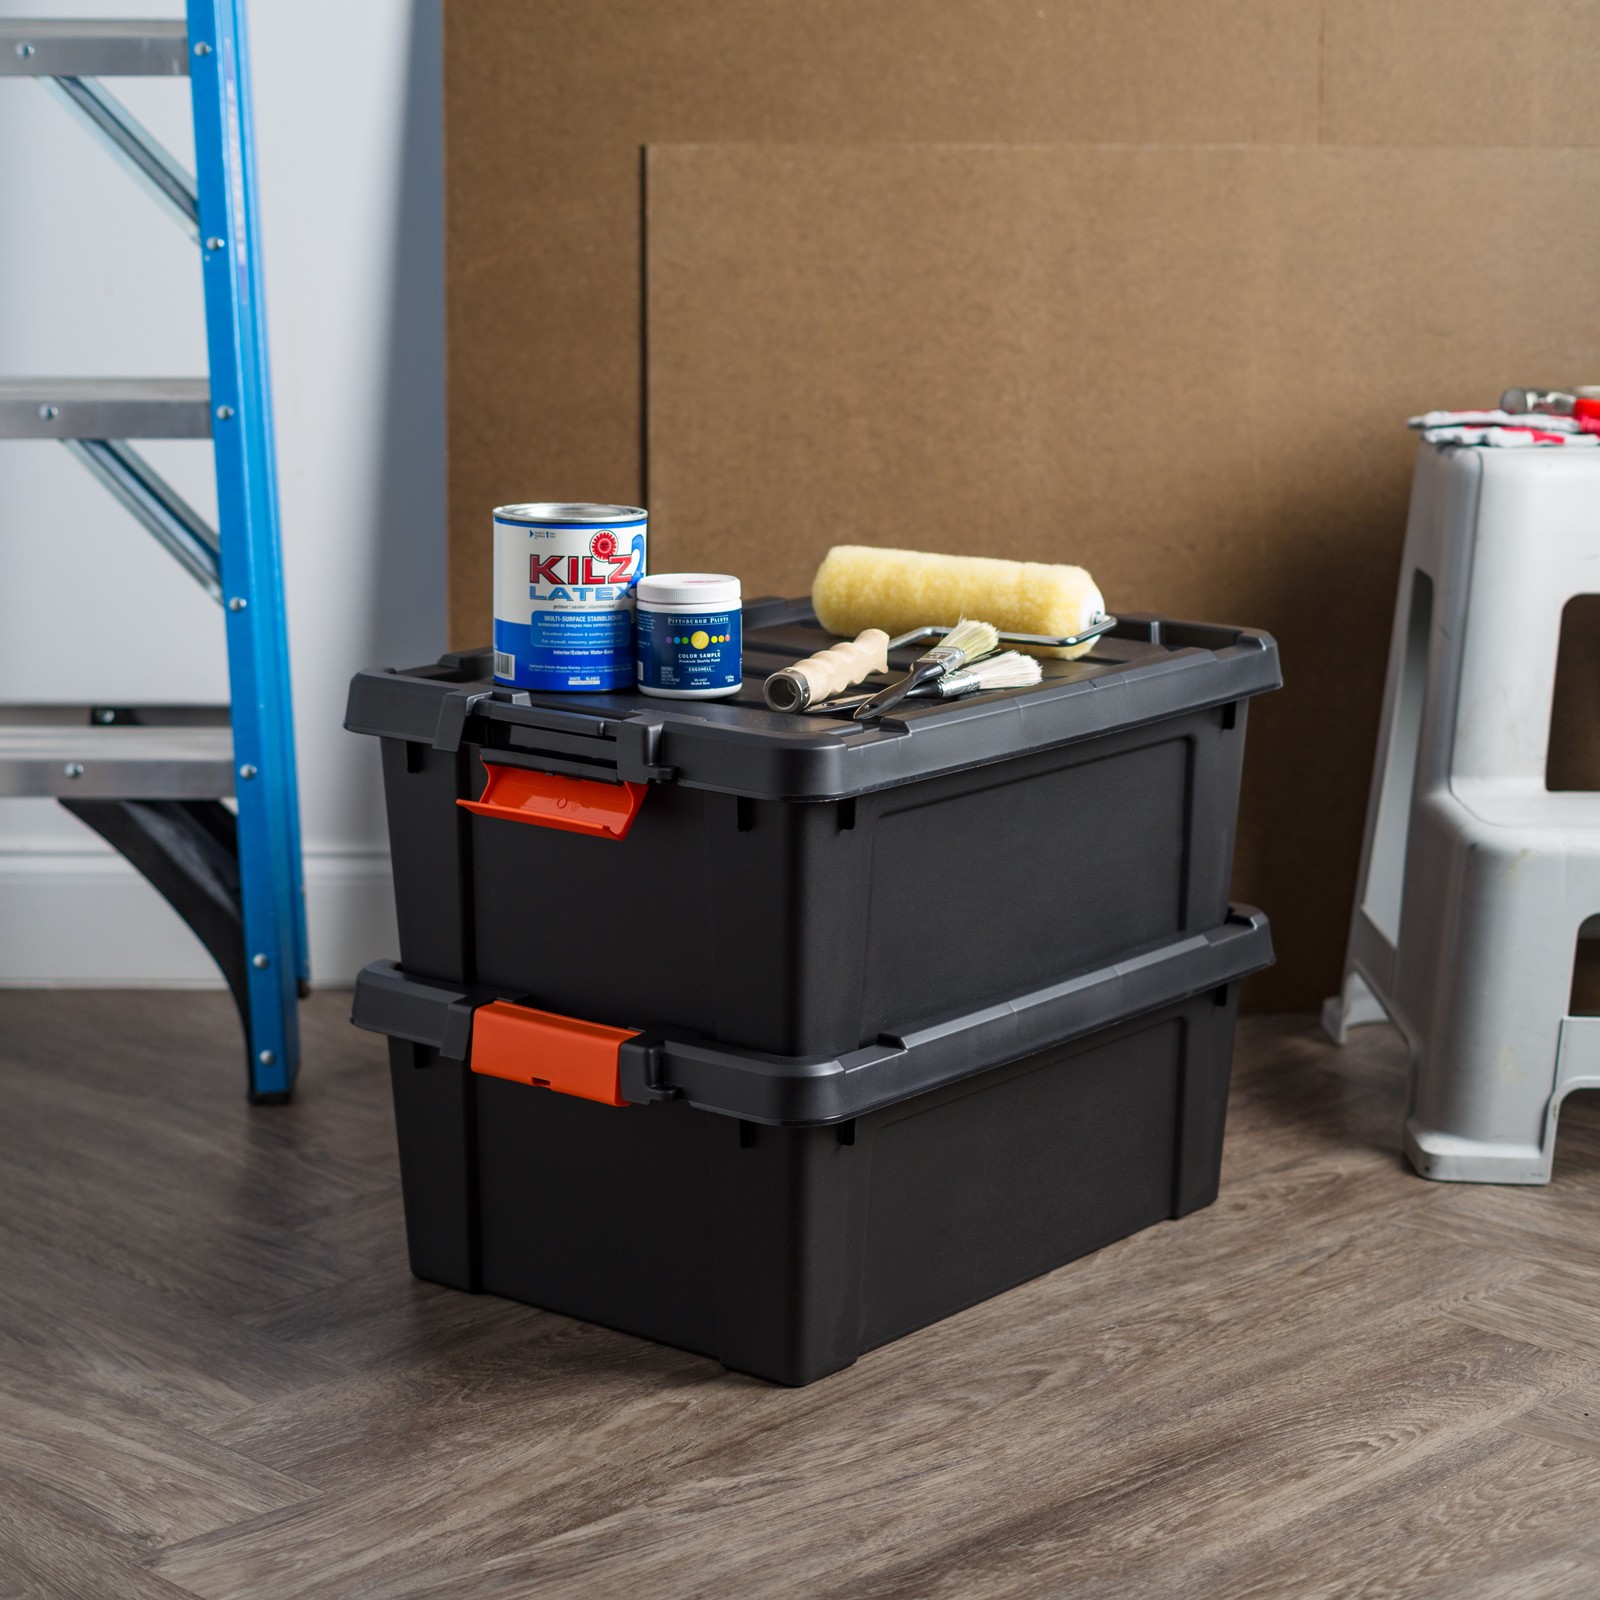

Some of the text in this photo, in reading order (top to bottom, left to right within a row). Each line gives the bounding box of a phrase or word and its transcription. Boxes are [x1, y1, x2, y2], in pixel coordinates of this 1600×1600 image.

[530, 554, 632, 585] KILZ
[530, 585, 634, 601] LATEX
[710, 616, 729, 624] PAINTS
